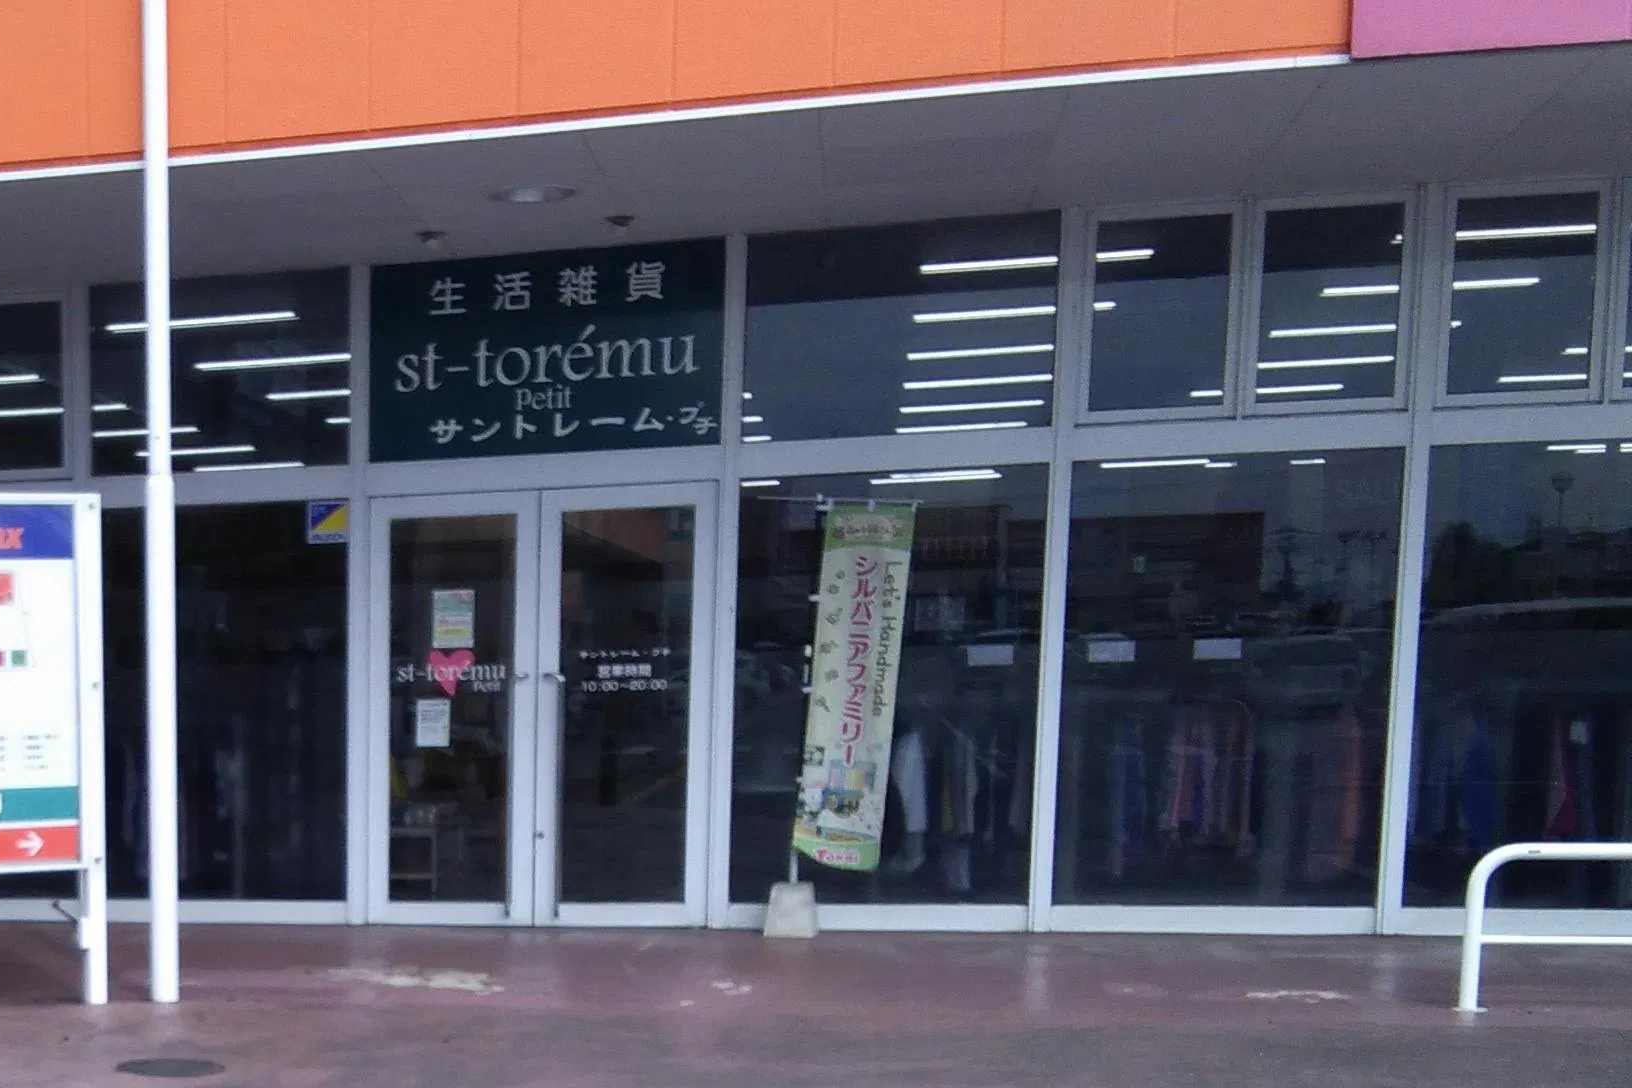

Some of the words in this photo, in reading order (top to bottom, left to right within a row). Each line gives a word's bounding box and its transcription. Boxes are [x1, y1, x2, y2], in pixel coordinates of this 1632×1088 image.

[428, 260, 667, 316] 生活雑貨
[394, 323, 701, 393] st-torému
[515, 387, 574, 411] Petit
[882, 559, 904, 607] Let's
[597, 662, 652, 679] 営業時間
[841, 555, 879, 767] シルバニアファミリー
[871, 614, 898, 717] Handmade
